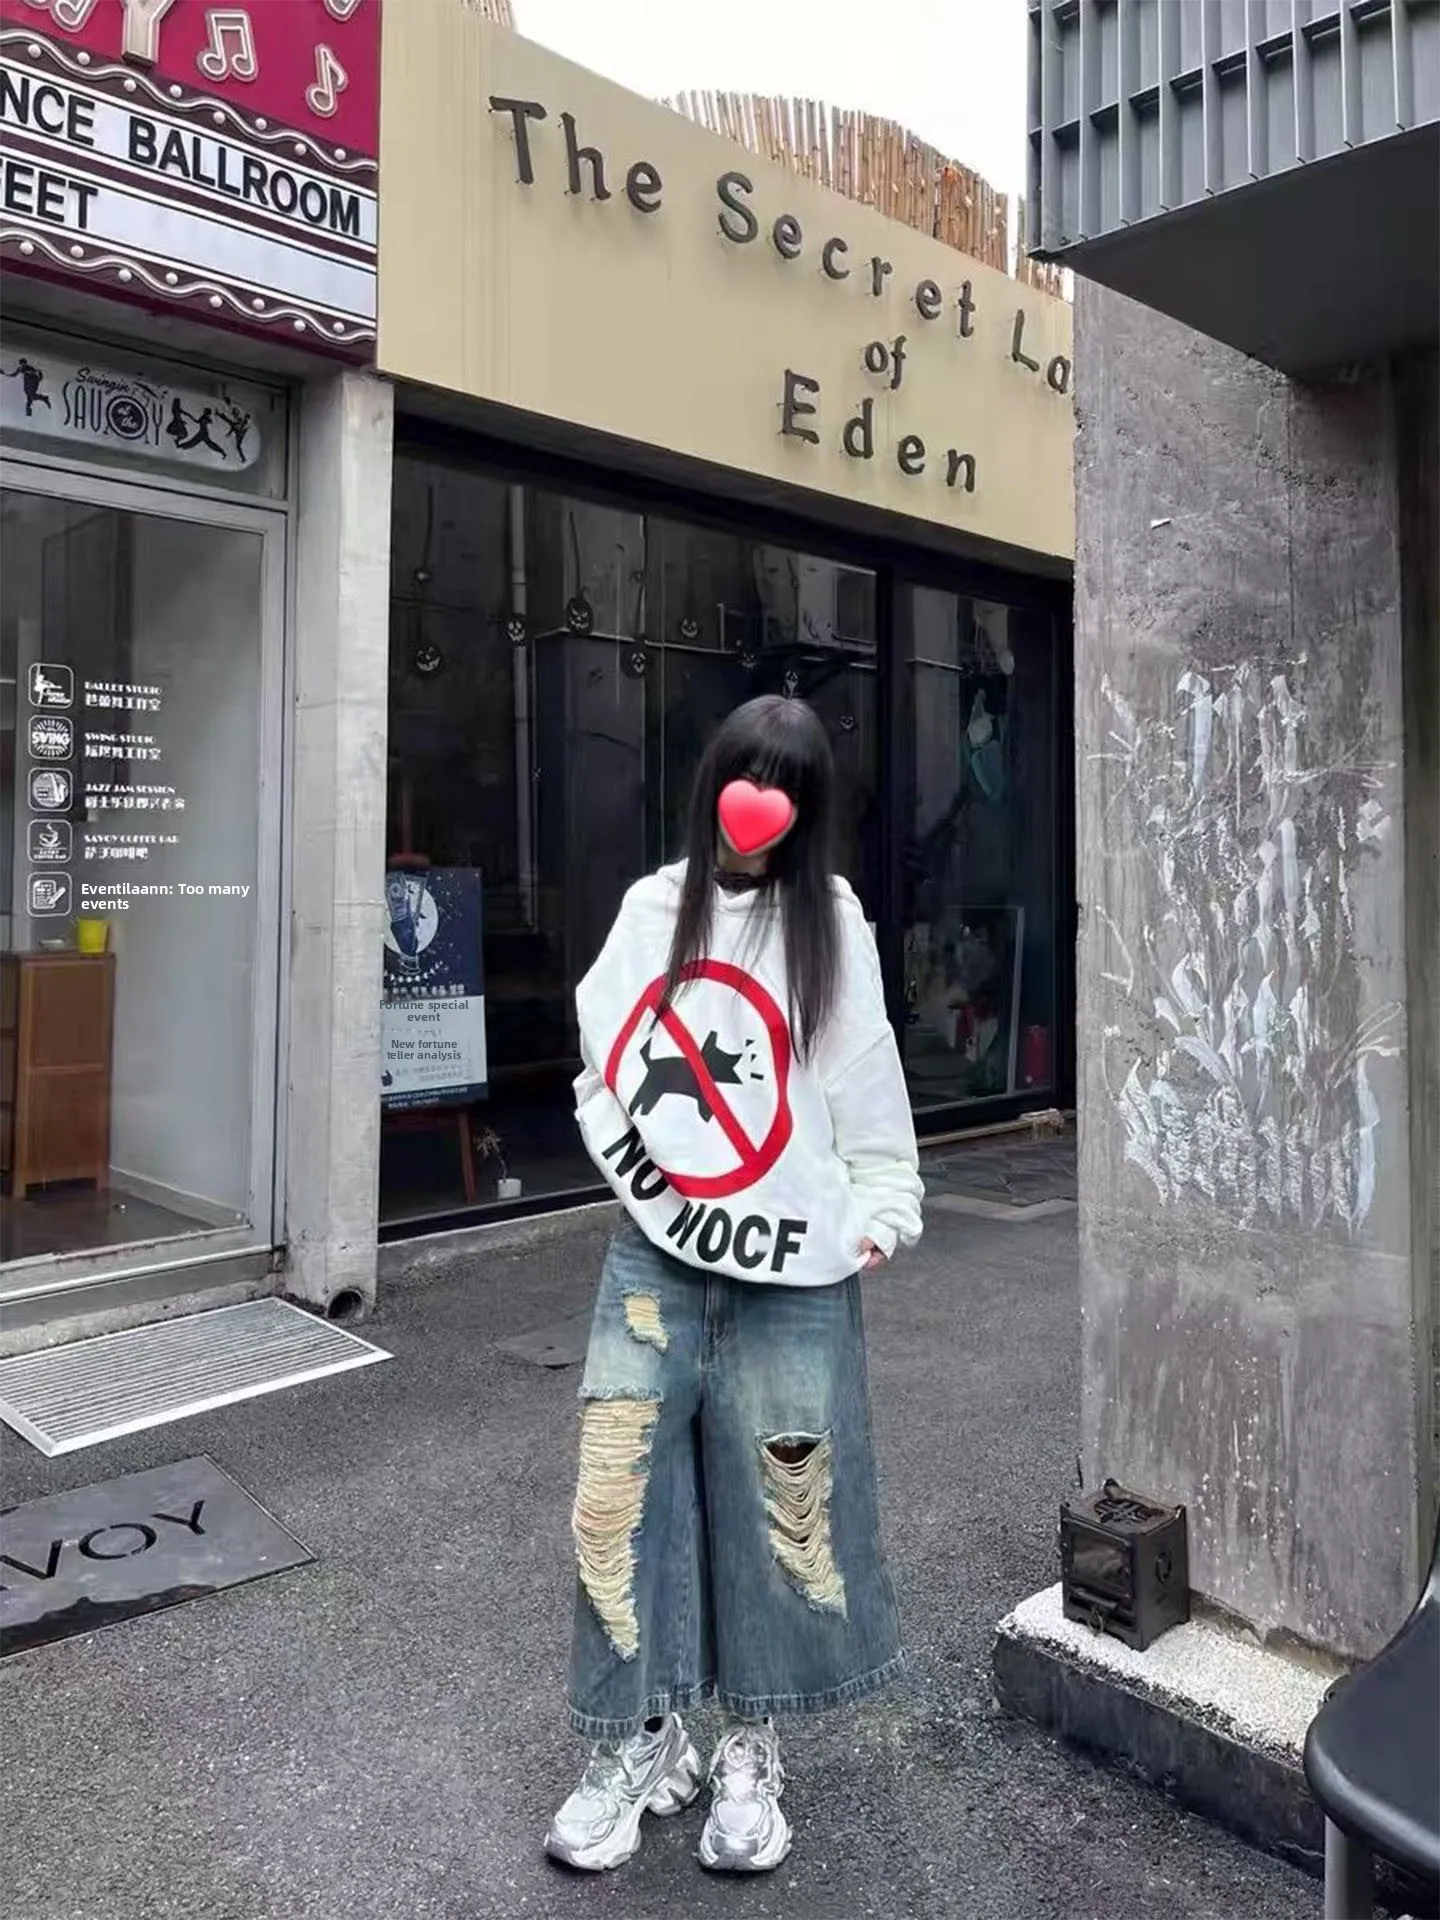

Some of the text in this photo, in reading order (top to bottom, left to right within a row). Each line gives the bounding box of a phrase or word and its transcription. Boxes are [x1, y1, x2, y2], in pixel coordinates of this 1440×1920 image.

[0, 69, 360, 236] NCE BALLROOM
[0, 158, 98, 229] EET
[489, 95, 1071, 395] The Secret La
[865, 335, 906, 389] of
[781, 368, 975, 492] Eden
[601, 1125, 671, 1201] NO
[0, 1500, 206, 1591] VOY
